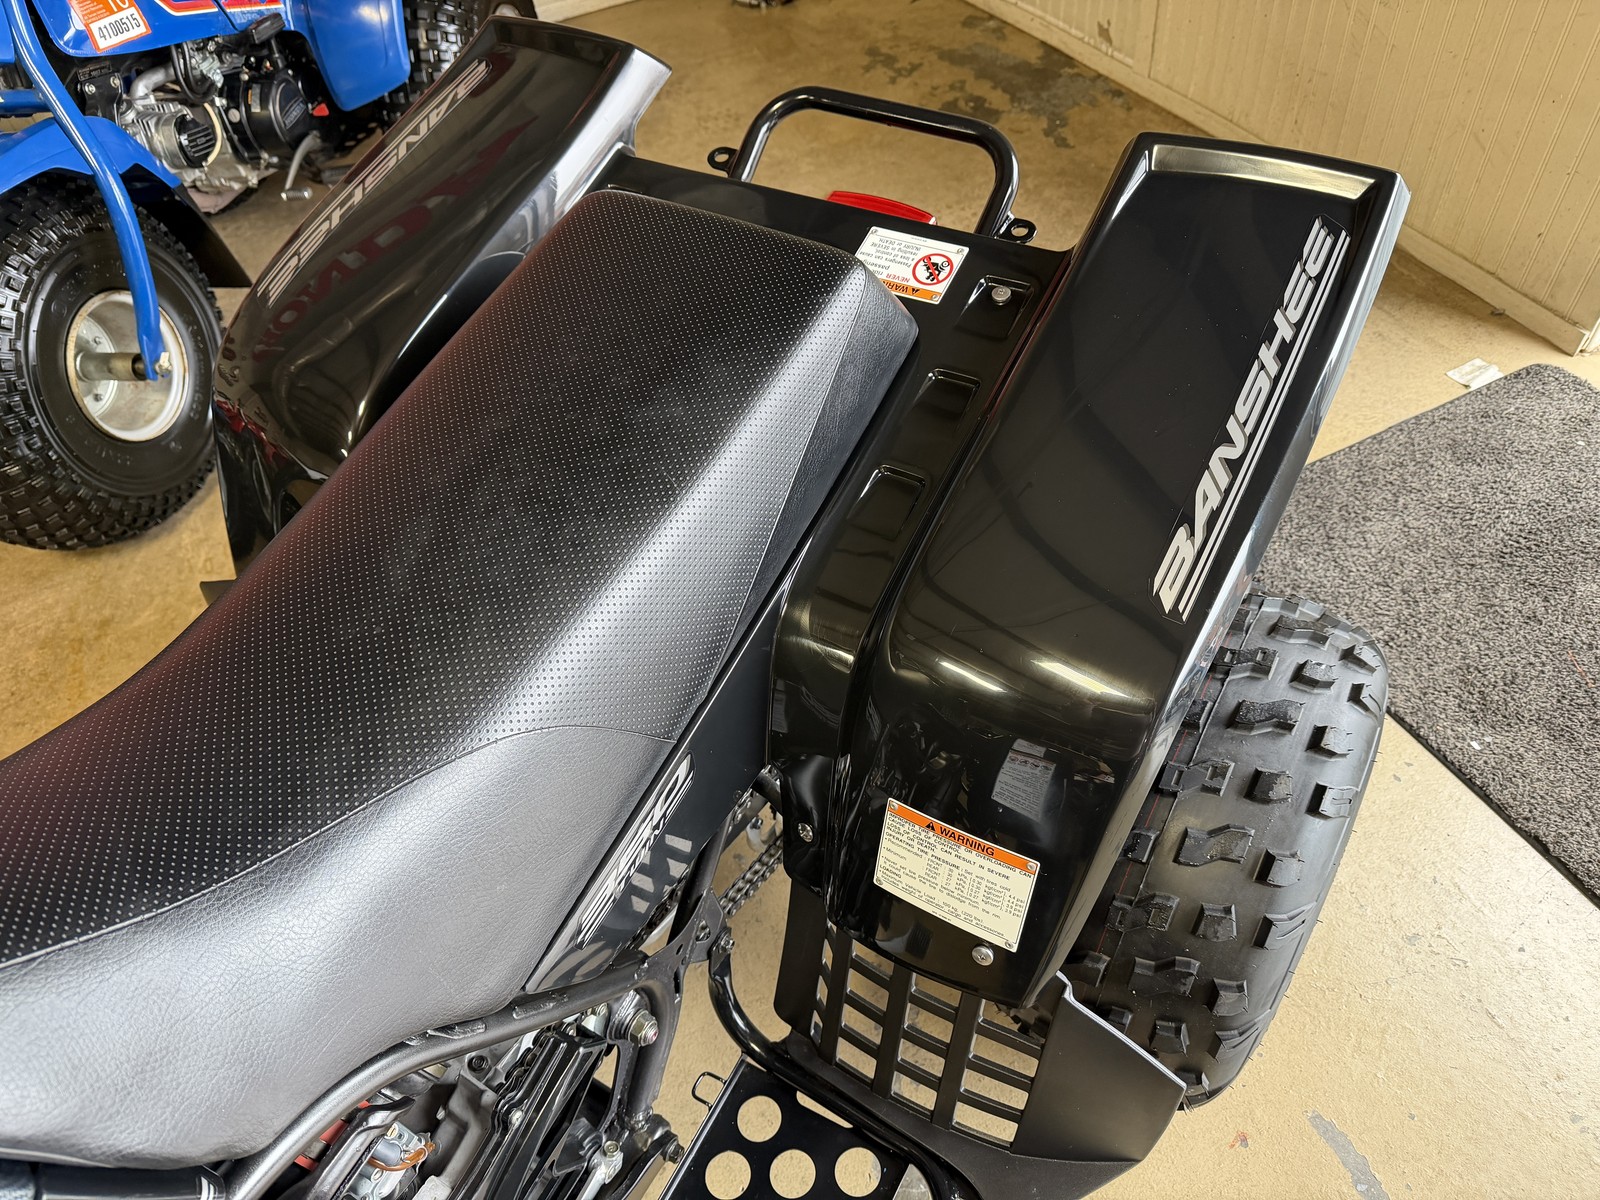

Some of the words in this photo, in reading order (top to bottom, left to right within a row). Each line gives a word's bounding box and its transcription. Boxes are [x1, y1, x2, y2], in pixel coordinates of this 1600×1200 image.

[98, 13, 141, 41] 4100515
[257, 59, 488, 309] BANSHEE
[869, 242, 890, 250] SEVERE
[883, 256, 912, 267] Passengers
[896, 247, 918, 256] resulting
[902, 243, 921, 251] INJURY
[884, 272, 910, 282] NEVER
[1153, 217, 1335, 613] BANSHEE
[886, 826, 904, 837] INJURY
[916, 841, 936, 852] DEATH.
[888, 816, 905, 828] CAUSE
[907, 826, 921, 836] LOSS
[939, 825, 995, 857] WARNING
[885, 831, 914, 848] OPERATING
[916, 847, 928, 855] TIRE
[986, 878, 997, 886] tires
[887, 821, 900, 831] LOSS
[912, 834, 938, 849] CONTROL
[940, 847, 951, 855] CAN
[954, 853, 975, 866] RESULT
[987, 866, 1010, 881] SEVERE
[888, 812, 915, 828] IMPROPER
[918, 826, 929, 834] TIRE
[932, 833, 961, 849] PRESSURE
[975, 851, 1016, 873] OVERLOADING
[1018, 870, 1031, 879] CAN
[879, 864, 901, 878] LOADING
[881, 870, 903, 884] Maximum
[904, 882, 921, 894] Vehicle
[923, 892, 935, 900] Load
[884, 856, 897, 865] Never
[918, 874, 938, 886] pressure
[940, 884, 954, 894] below
[885, 847, 906, 860] Minimum
[925, 866, 940, 876] FRONT
[1013, 907, 1022, 915] psi
[887, 837, 922, 859] Recommended
[927, 857, 942, 867] FRONT
[1016, 897, 1025, 905] psi
[888, 863, 900, 872] could
[902, 870, 916, 880] cause
[945, 891, 965, 904] dislodge
[968, 901, 979, 910] from
[926, 862, 938, 871] REAR
[1014, 902, 1023, 910] psi
[880, 874, 899, 886] Includes
[901, 885, 915, 896] weight
[947, 908, 961, 918] cargo
[924, 871, 936, 880] REAR
[1012, 911, 1021, 919] psi
